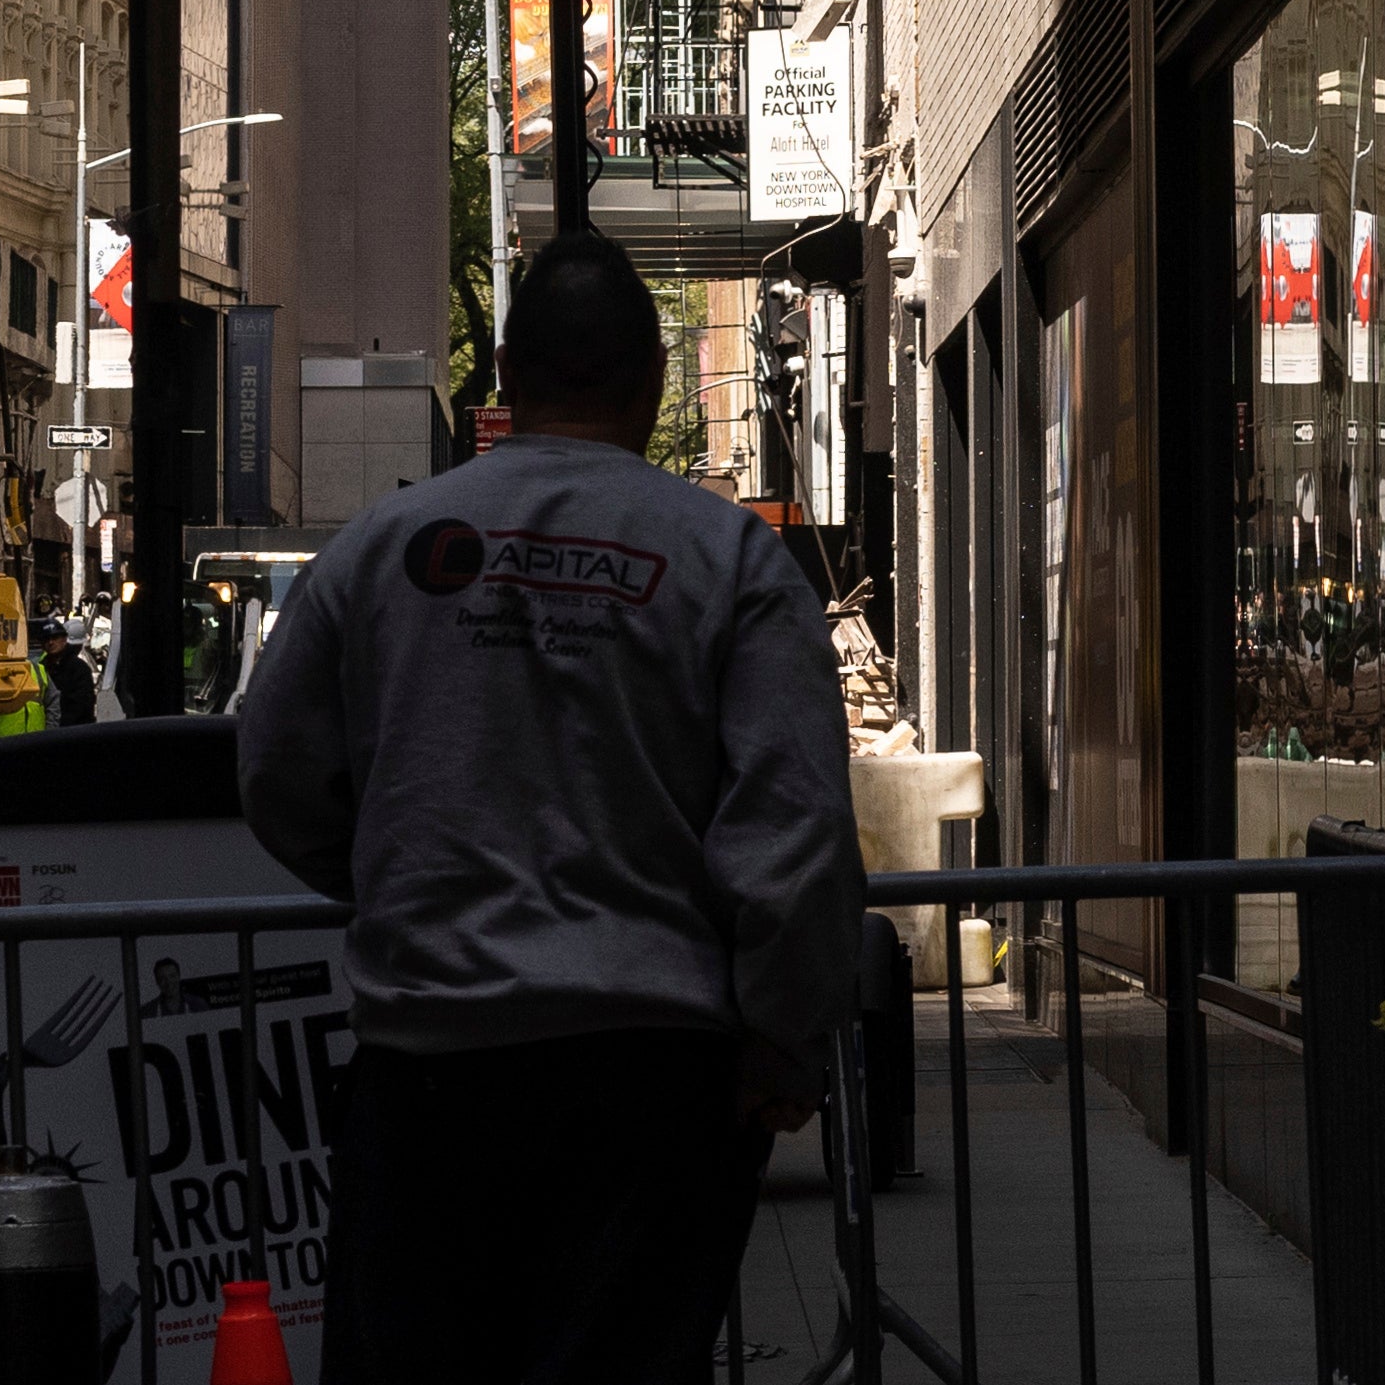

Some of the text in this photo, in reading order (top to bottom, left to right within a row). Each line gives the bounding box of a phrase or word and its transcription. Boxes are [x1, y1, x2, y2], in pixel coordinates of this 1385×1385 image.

[774, 66, 826, 81] Official
[765, 82, 835, 99] PARKING
[762, 100, 837, 117] FACILITY
[770, 135, 830, 153] Aloft Hotel
[770, 170, 831, 182] NEW YORK
[766, 182, 837, 196] DOWNTOWN
[775, 196, 827, 209] HOSPITAL
[233, 319, 269, 333] BAR
[239, 365, 257, 474] RECREATION
[56, 432, 102, 443] ONE WAY
[31, 863, 77, 876] FOSUN
[133, 1156, 334, 1257] AROUN
[158, 1317, 193, 1333] feast
[196, 1313, 210, 1327] of
[272, 1298, 325, 1314] nhattan
[166, 1331, 191, 1346] one
[280, 1313, 297, 1328] od
